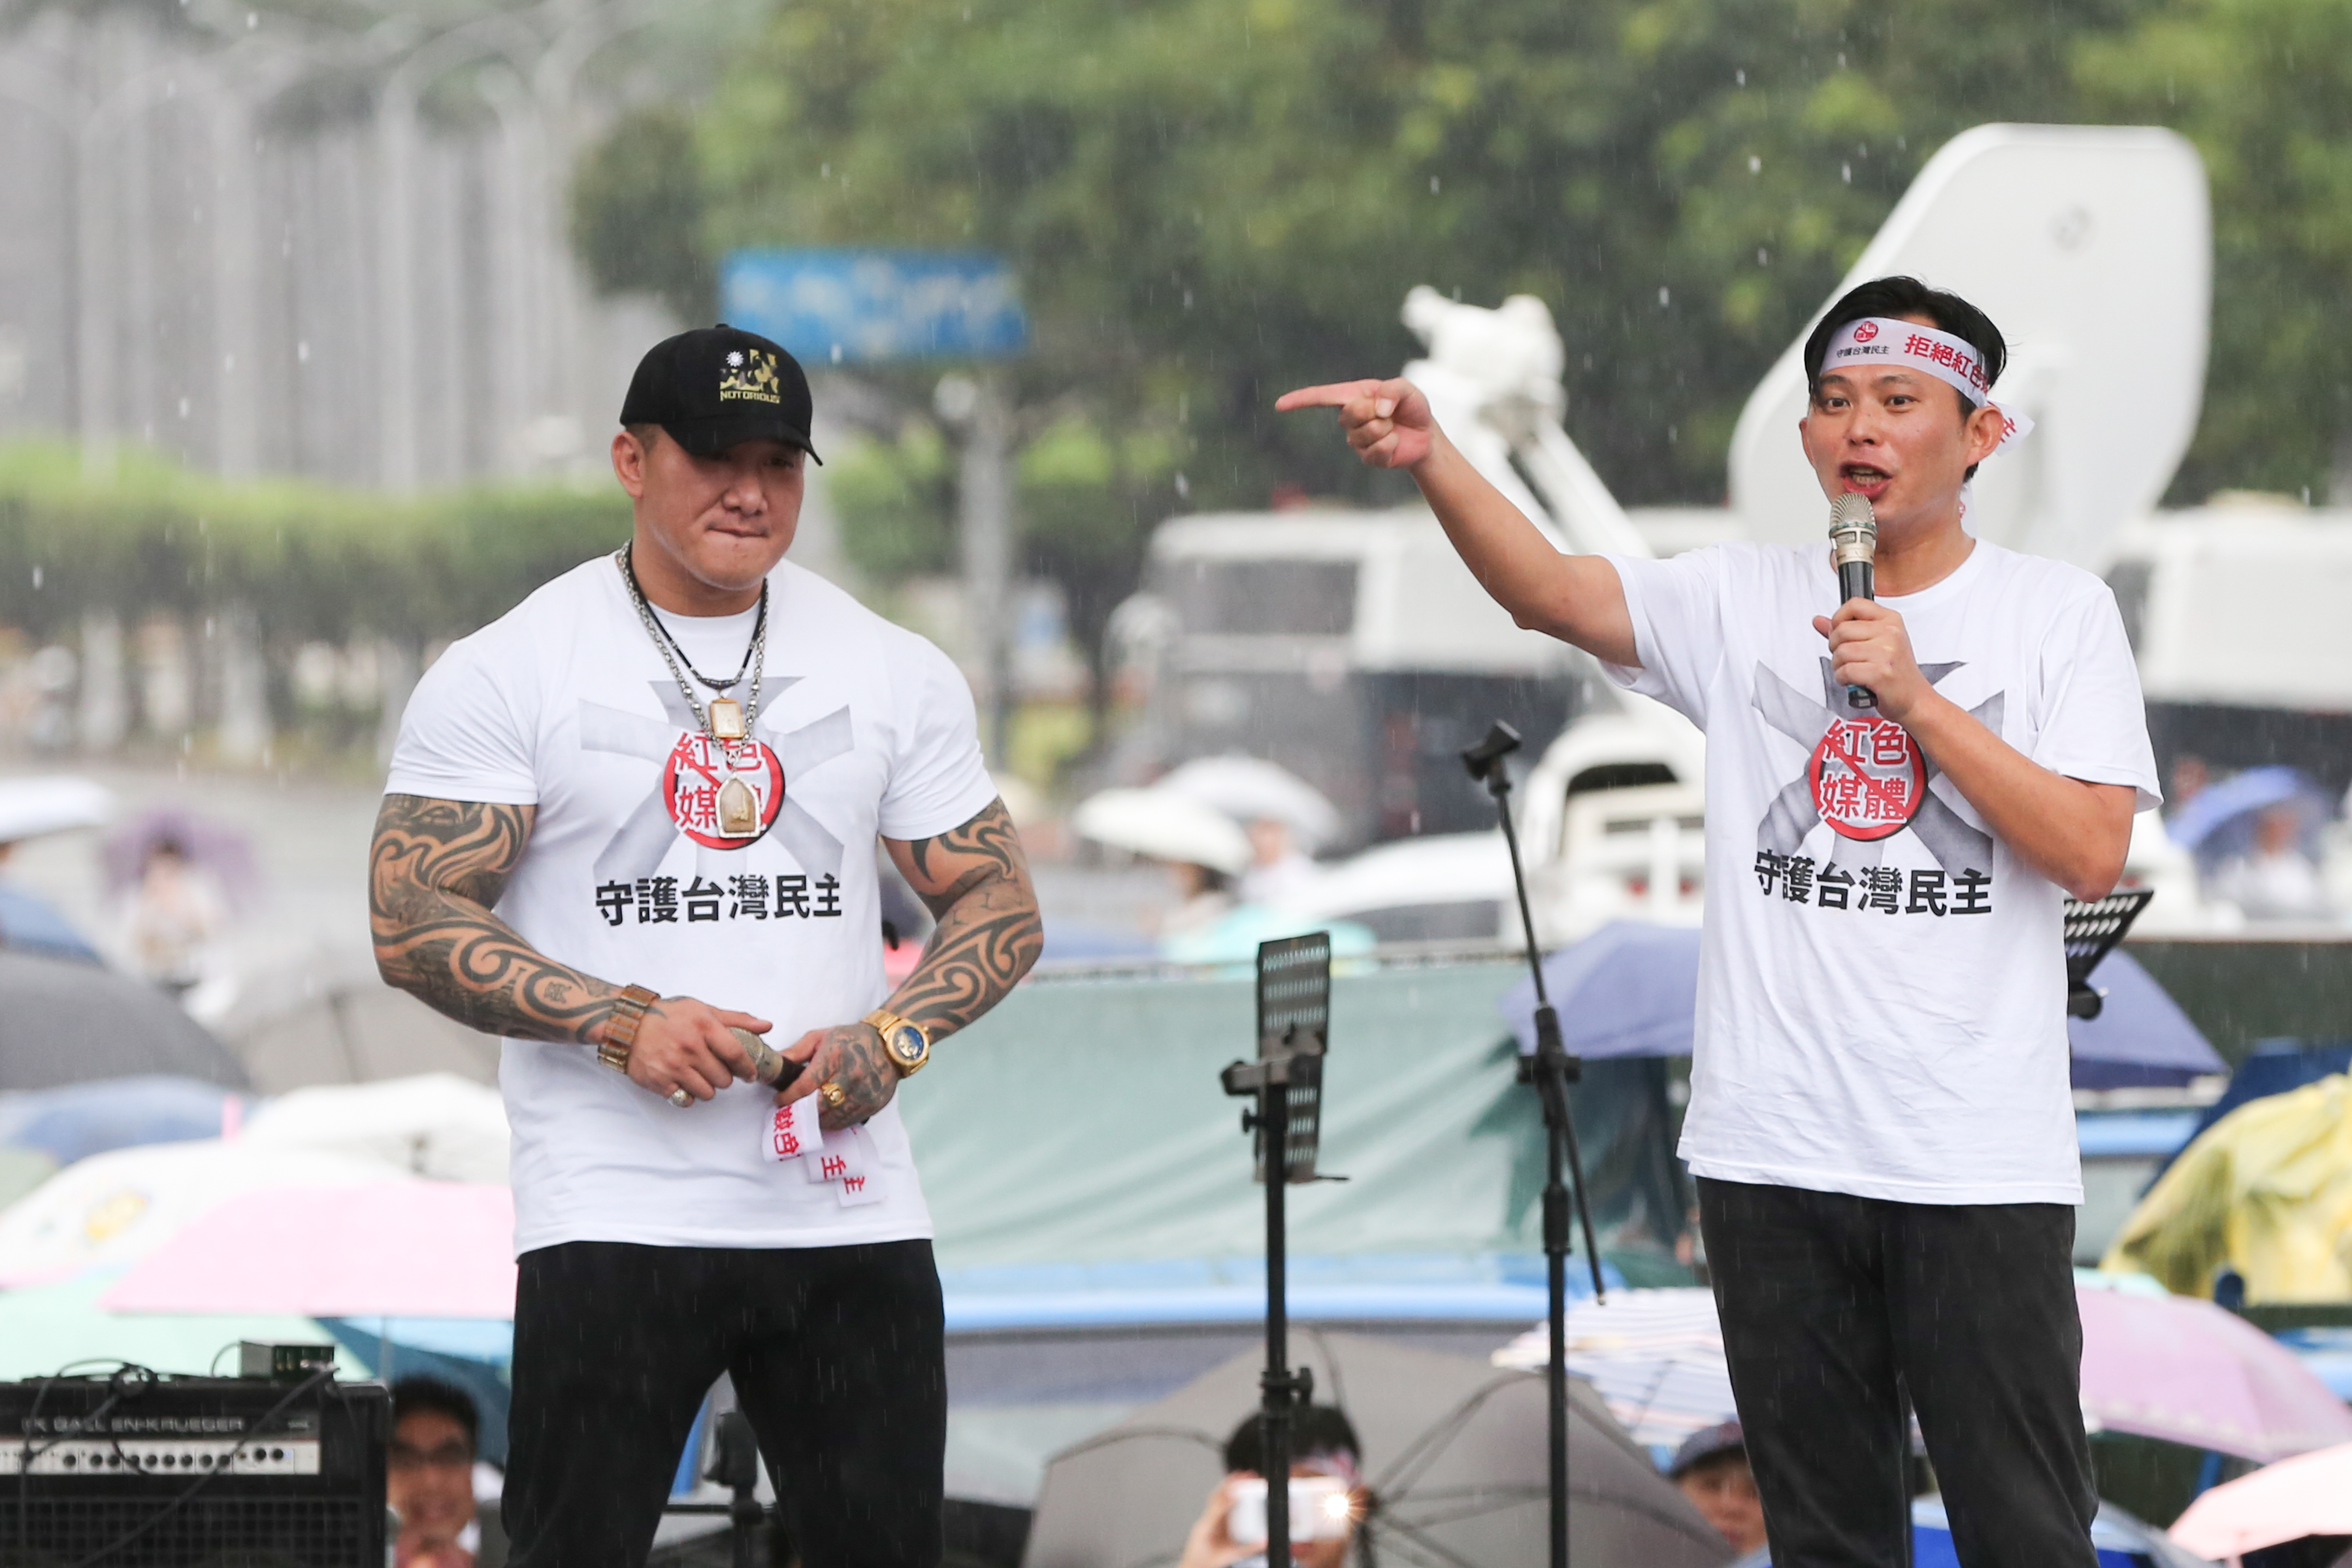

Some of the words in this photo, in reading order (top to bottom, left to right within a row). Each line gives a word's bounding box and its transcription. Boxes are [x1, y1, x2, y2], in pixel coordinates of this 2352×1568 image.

[1837, 345, 1889, 357] 守護台灣民主
[1904, 333, 1989, 395] 拒絕紅色
[720, 391, 781, 404] NOTORIOUS
[1825, 719, 1907, 765] 紅色
[1820, 774, 1906, 821] 媒體
[596, 873, 842, 926] 守護台灣民主
[1754, 849, 1992, 917] 守護台灣民主
